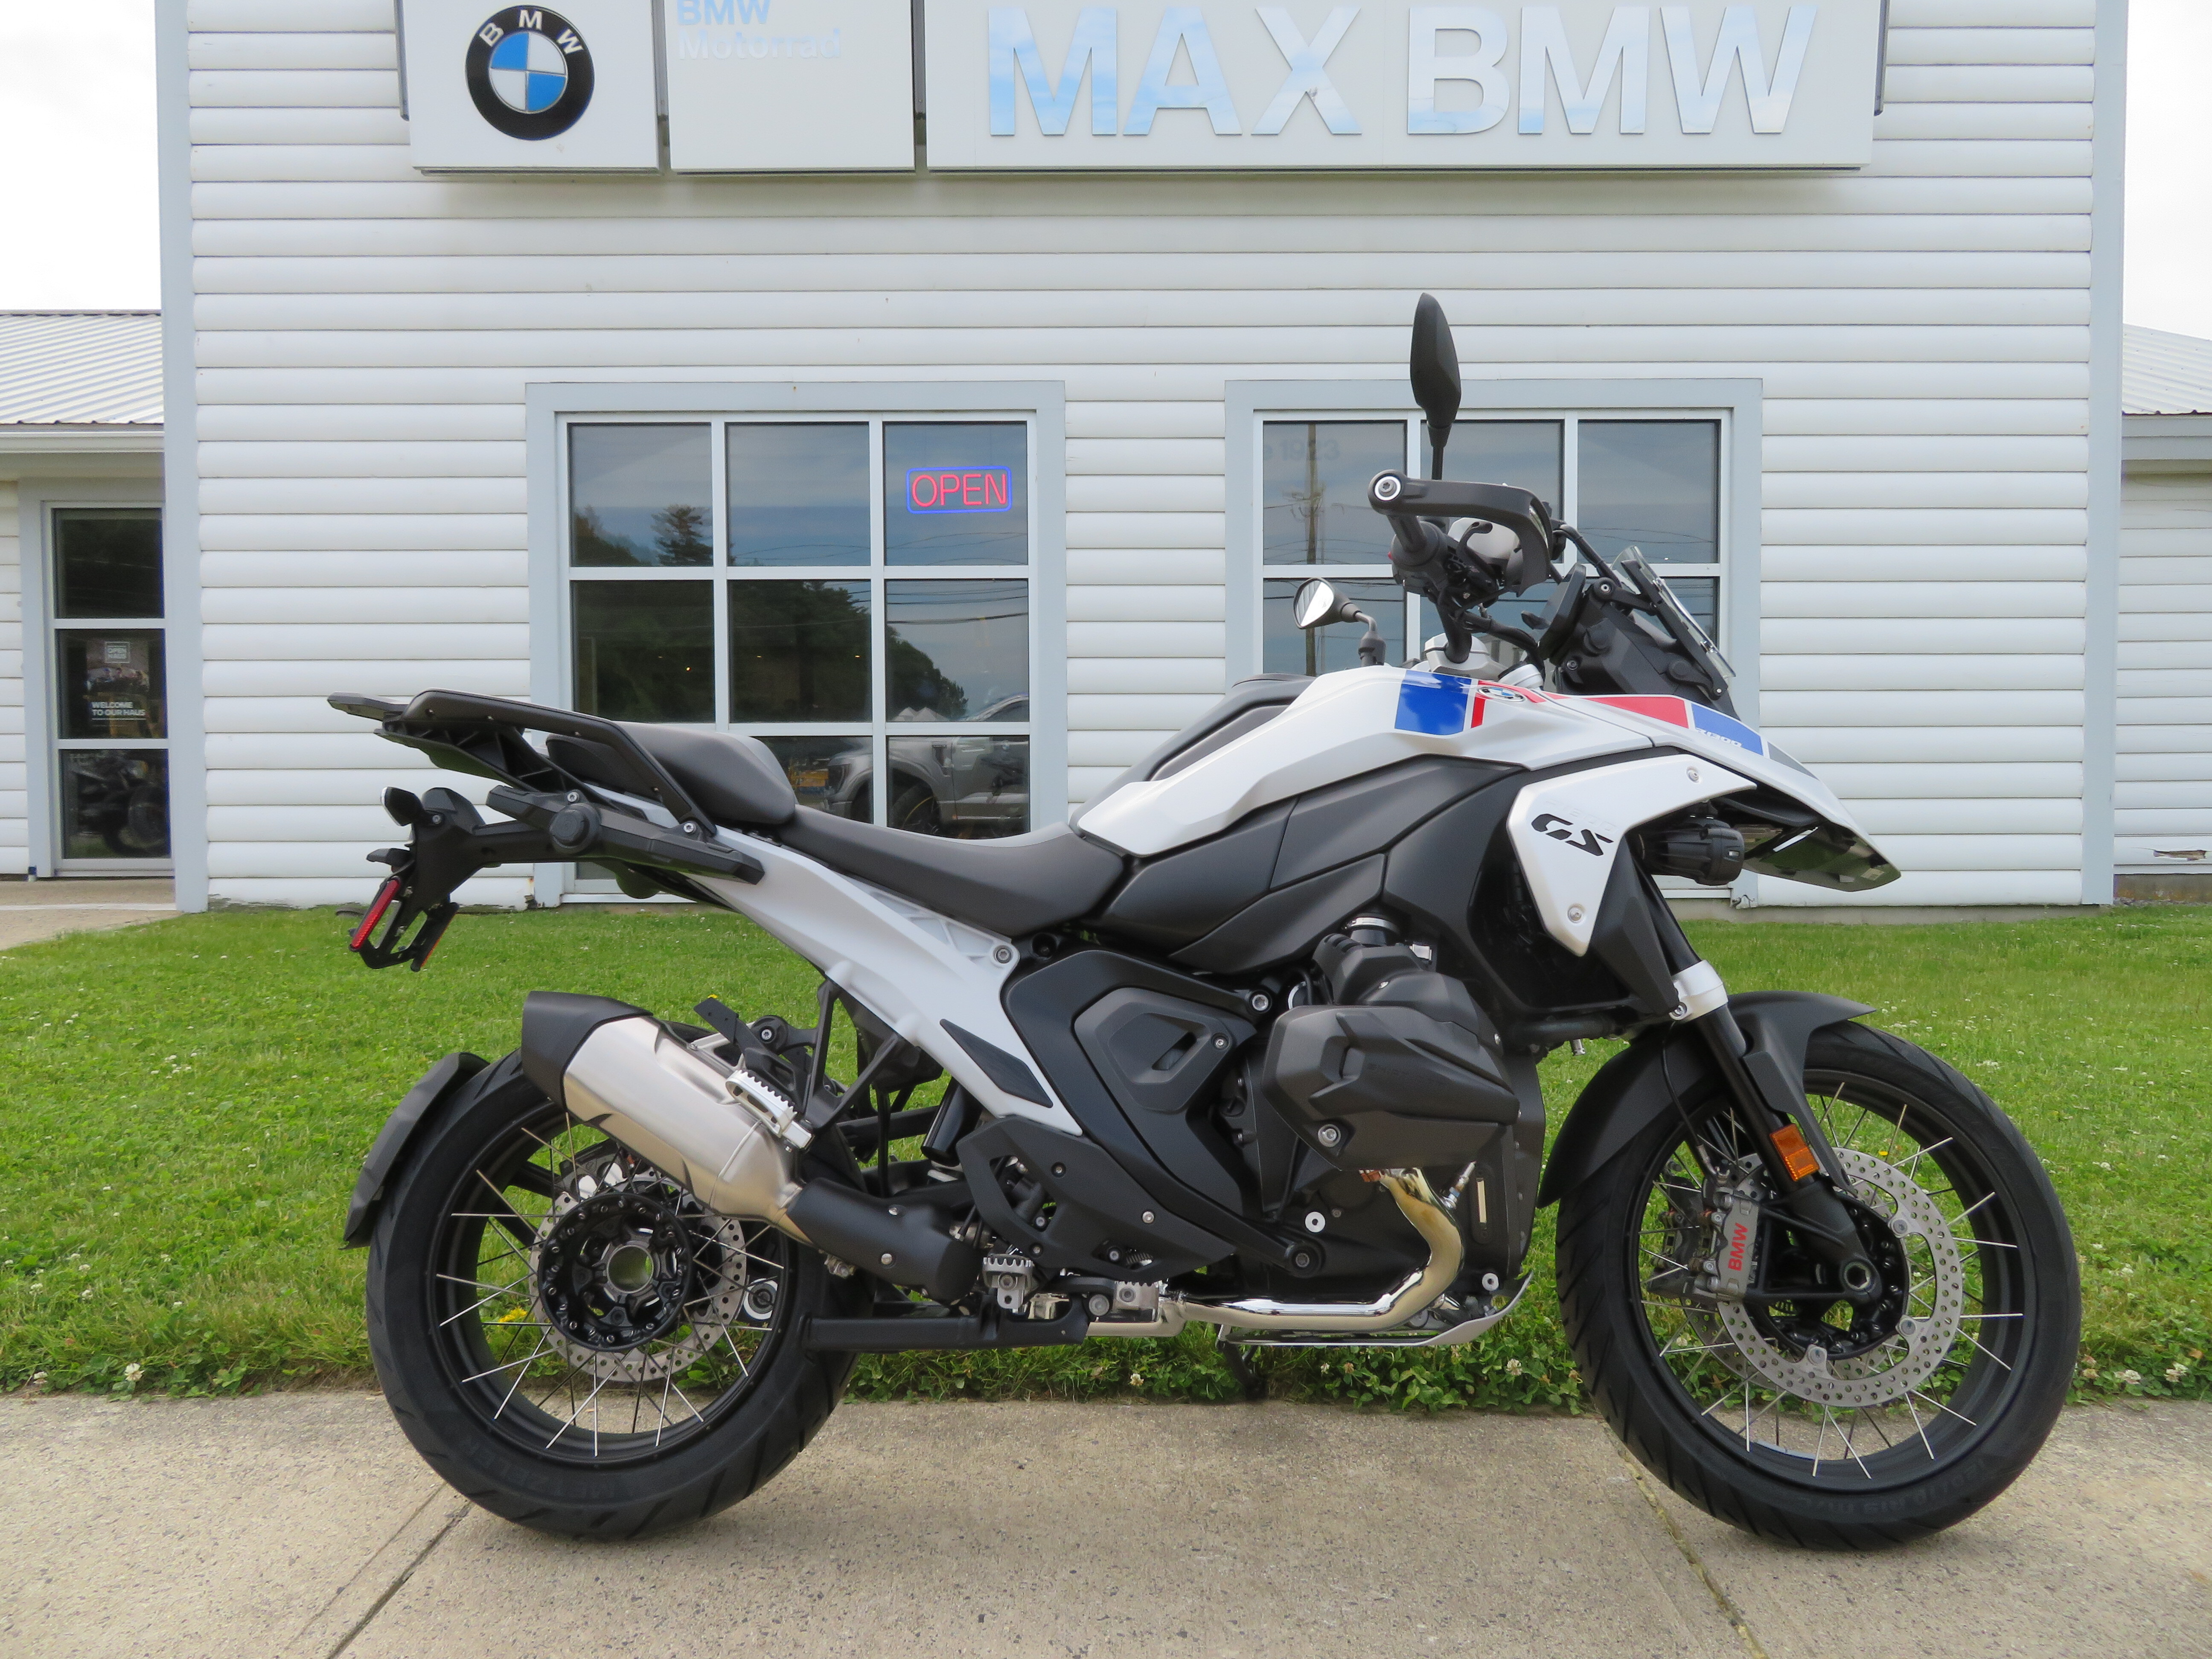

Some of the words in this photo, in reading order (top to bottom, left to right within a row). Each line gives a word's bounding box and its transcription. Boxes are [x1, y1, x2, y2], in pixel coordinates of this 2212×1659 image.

[479, 9, 584, 54] BMW
[677, 0, 771, 25] BMW
[678, 27, 841, 60] Motorrad
[988, 6, 1363, 136] MAX
[1406, 5, 1818, 135] BMW
[911, 473, 1007, 507] OPEN
[1531, 813, 1615, 856] GS
[1728, 1222, 1748, 1271] BMW
